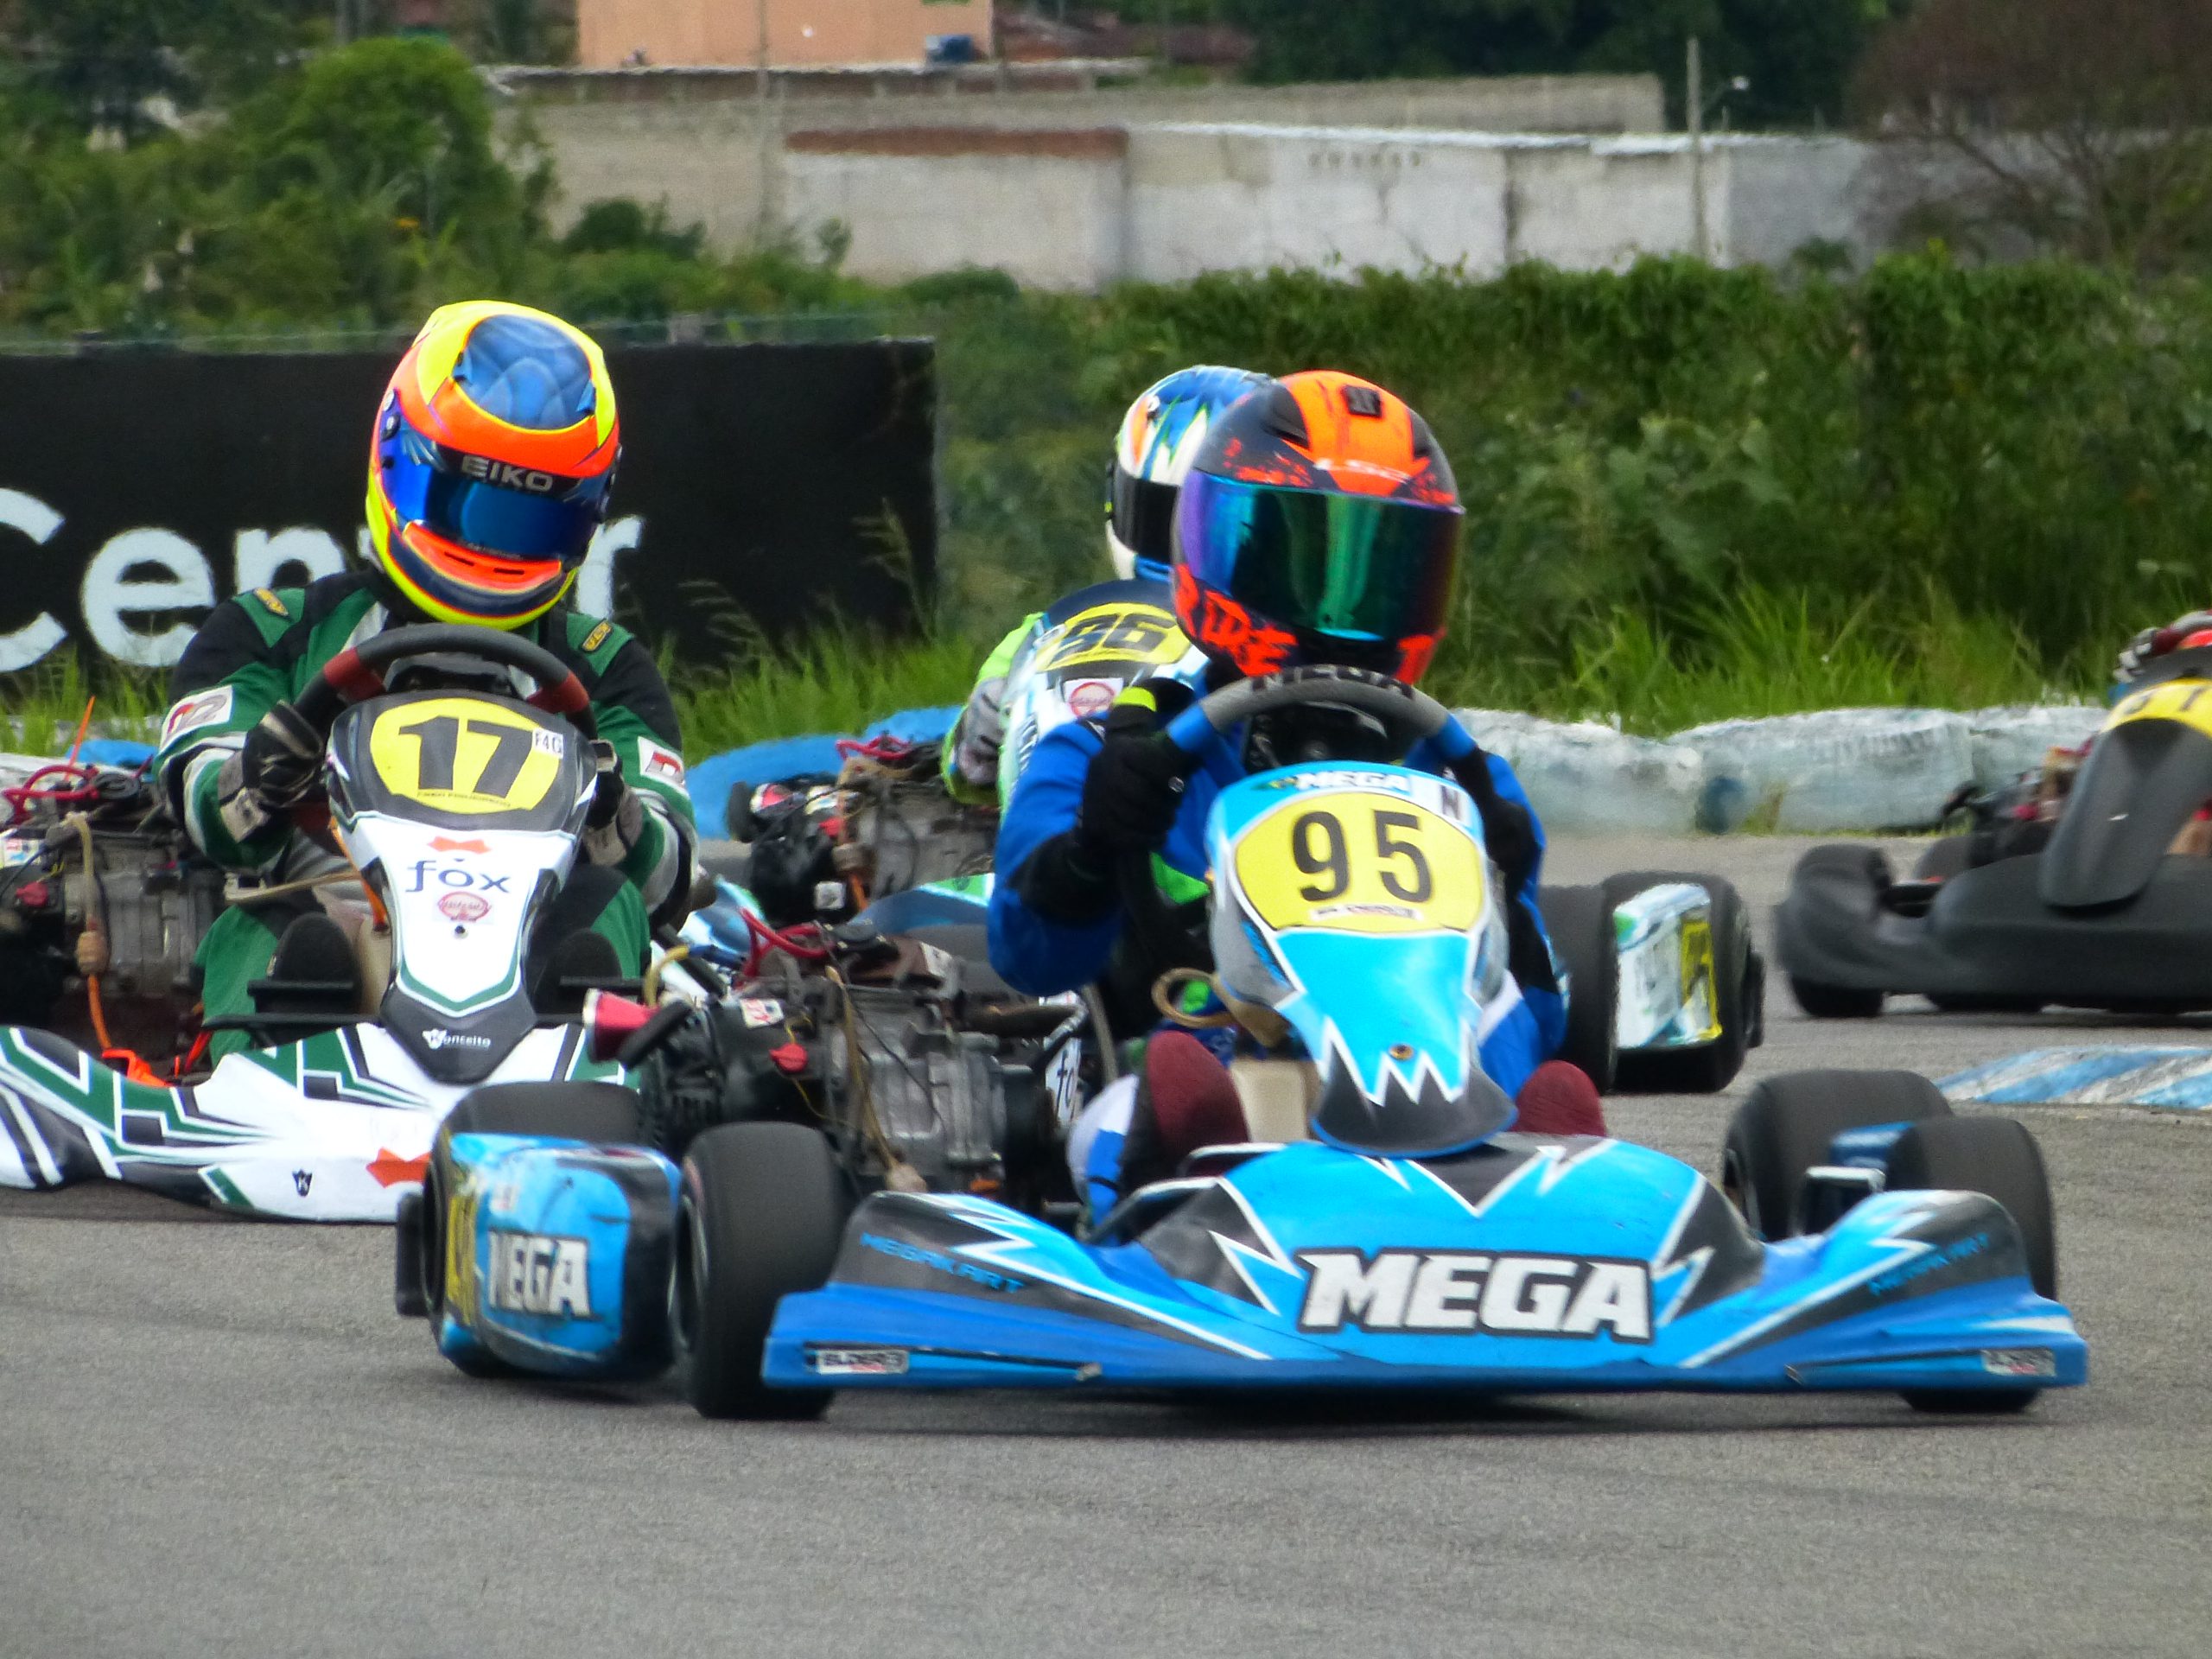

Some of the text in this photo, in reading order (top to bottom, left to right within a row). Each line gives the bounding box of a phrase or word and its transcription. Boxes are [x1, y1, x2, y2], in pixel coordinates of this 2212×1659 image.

[461, 454, 554, 493] EIKO
[398, 715, 534, 799] 17
[1294, 770, 1410, 795] MEGA
[405, 859, 511, 893] fox
[1293, 810, 1433, 903] 95
[1297, 1253, 1651, 1339] MEGA
